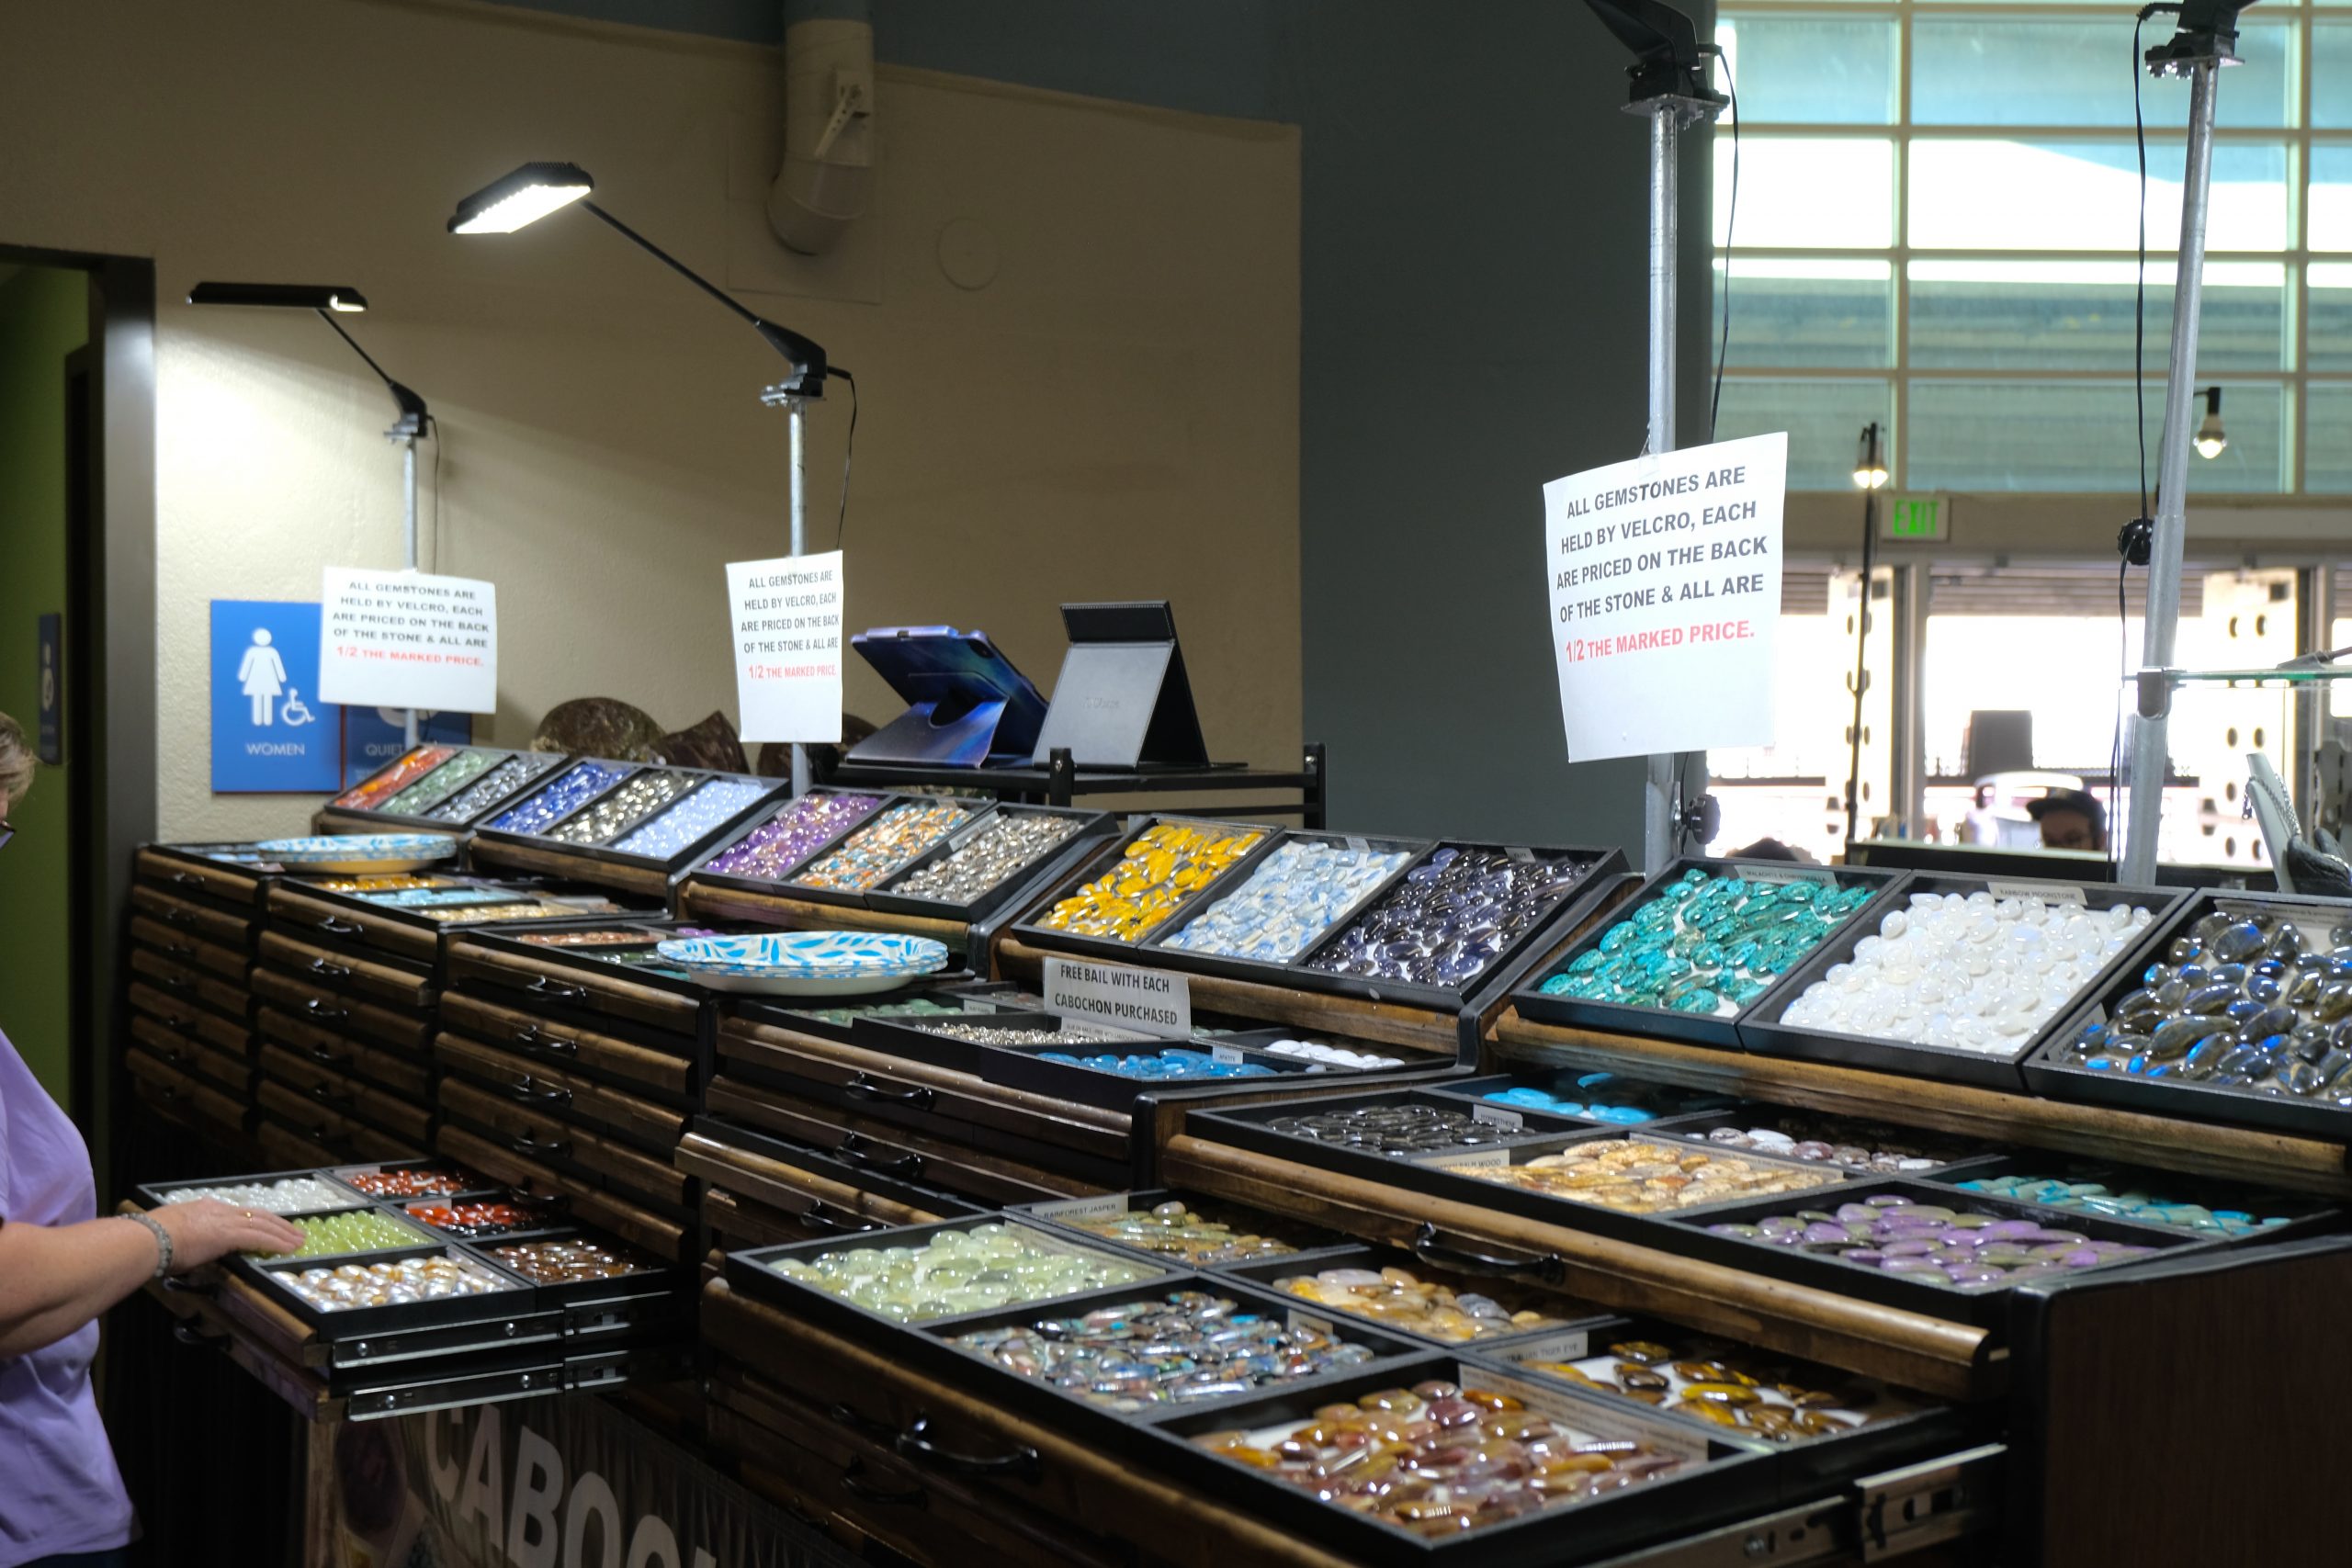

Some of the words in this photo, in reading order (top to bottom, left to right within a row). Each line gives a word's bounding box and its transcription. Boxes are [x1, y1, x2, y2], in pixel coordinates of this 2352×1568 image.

[1567, 498, 1590, 519] ALL
[1595, 474, 1699, 511] GEMSTONES
[1705, 466, 1746, 489] ARE
[1561, 533, 1592, 554] HELD
[1598, 525, 1615, 545] BY
[1622, 512, 1695, 539] VELCRO,
[1702, 501, 1756, 525] EACH
[1894, 501, 1939, 536] EXIT
[1556, 569, 1578, 590] ARE
[1582, 558, 1632, 583] PRICED
[1637, 552, 1661, 571] ON
[1668, 545, 1704, 566] THE
[1711, 536, 1767, 560] BACK
[749, 577, 765, 588] ALL
[769, 572, 818, 587] GEMSTONES
[820, 570, 832, 581] ARE
[349, 581, 369, 591] ALL
[376, 584, 449, 596] GEMSTONES
[455, 591, 476, 600] ARE
[1560, 604, 1573, 623] OF
[1577, 598, 1600, 618] THE
[1605, 588, 1655, 613] STONE
[1662, 585, 1672, 603] &
[1679, 580, 1713, 600] ALL
[1721, 574, 1763, 594] ARE
[341, 597, 372, 606] HELD
[377, 600, 392, 608] BY
[398, 602, 448, 614] VELCRO,
[453, 605, 483, 615] EACH
[744, 599, 768, 610] HELD
[772, 597, 783, 608] BY
[786, 594, 818, 607] VELCRO,
[820, 592, 836, 604] EACH
[333, 613, 356, 621] ARE
[361, 615, 405, 625] PRICED
[410, 618, 426, 626] ON
[432, 619, 455, 628] THE
[459, 622, 489, 632] BACK
[741, 621, 759, 632] ARE
[763, 618, 792, 631] PRICED
[795, 617, 805, 628] ON
[808, 616, 821, 627] THE
[823, 615, 839, 626] BACK
[334, 628, 349, 637] OF
[354, 630, 377, 639] THE
[382, 632, 422, 642] STONE
[440, 636, 460, 645] ALL
[466, 638, 488, 648] ARE
[744, 643, 755, 653] OF
[758, 642, 775, 652] THE
[778, 640, 803, 651] STONE
[806, 640, 810, 649] &
[813, 638, 825, 649] ALL
[827, 637, 838, 648] ARE
[1566, 639, 1584, 662] 1/2
[1588, 638, 1611, 658] THE
[1616, 628, 1682, 653] MARKED
[1690, 620, 1755, 643] PRICE.
[337, 646, 357, 657] 1/2
[363, 649, 385, 659] THE
[390, 651, 442, 663] MARKED
[446, 656, 484, 666] PRICE.
[749, 665, 763, 679] 1/2
[766, 668, 782, 678] THE
[785, 666, 815, 677] MARKED
[246, 743, 304, 756] WOMEN
[1060, 964, 1081, 979] FREE
[1085, 969, 1108, 984] BAIL
[1111, 972, 1139, 988] WITH
[1143, 976, 1169, 992] EACH
[1055, 993, 1112, 1014] CABOCHON
[1115, 1002, 1177, 1025] PURCHASED
[1479, 1158, 1500, 1168] WOOD
[1044, 1207, 1087, 1218] RAINFOREST
[1090, 1203, 1115, 1213] JASPER
